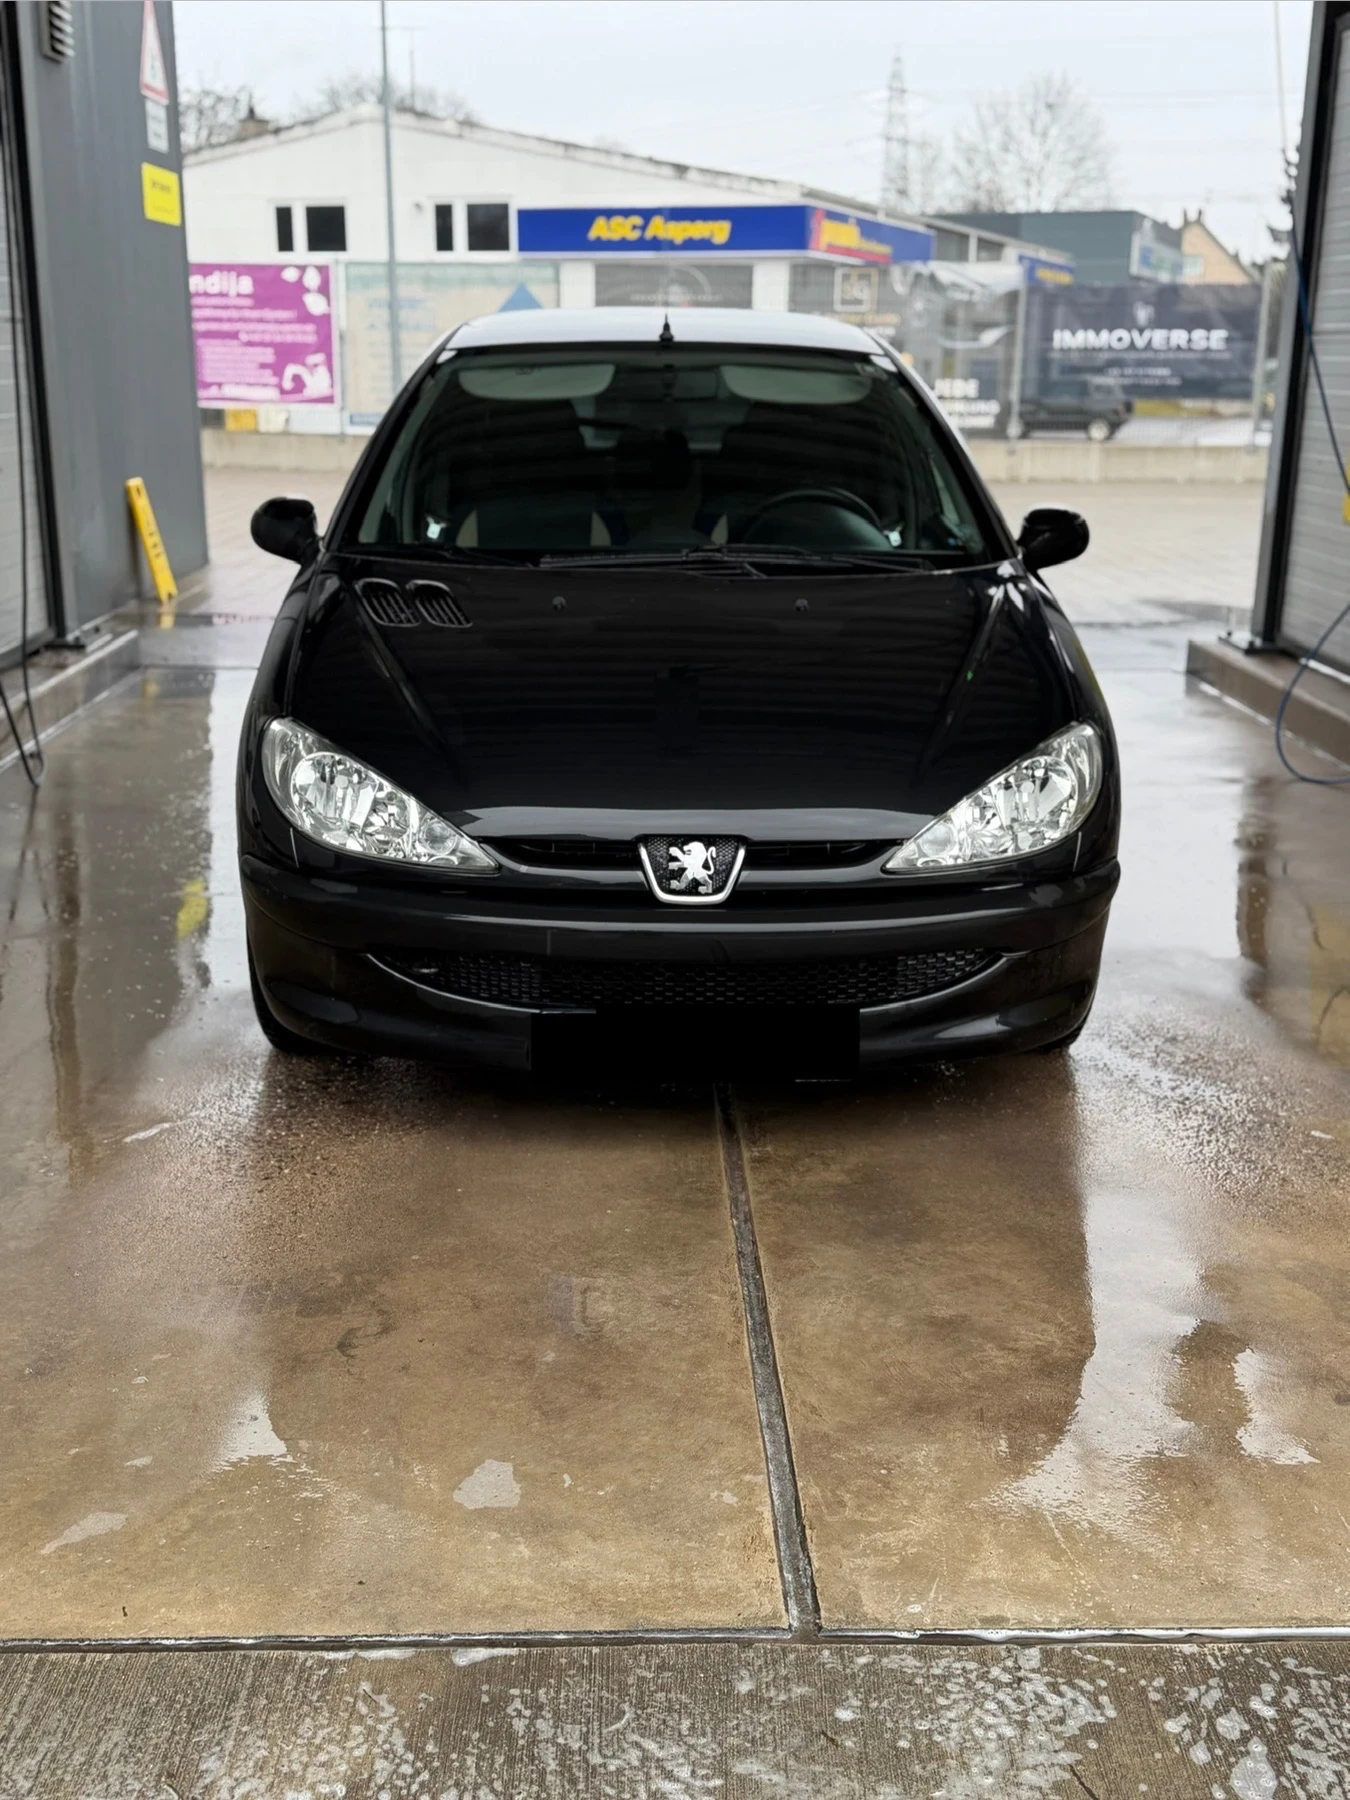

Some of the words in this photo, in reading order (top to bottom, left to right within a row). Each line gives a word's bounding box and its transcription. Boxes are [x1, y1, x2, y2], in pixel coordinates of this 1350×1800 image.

[588, 215, 643, 240] ASC
[644, 215, 732, 244] Asperg
[1053, 328, 1228, 350] IMMOVERSE
